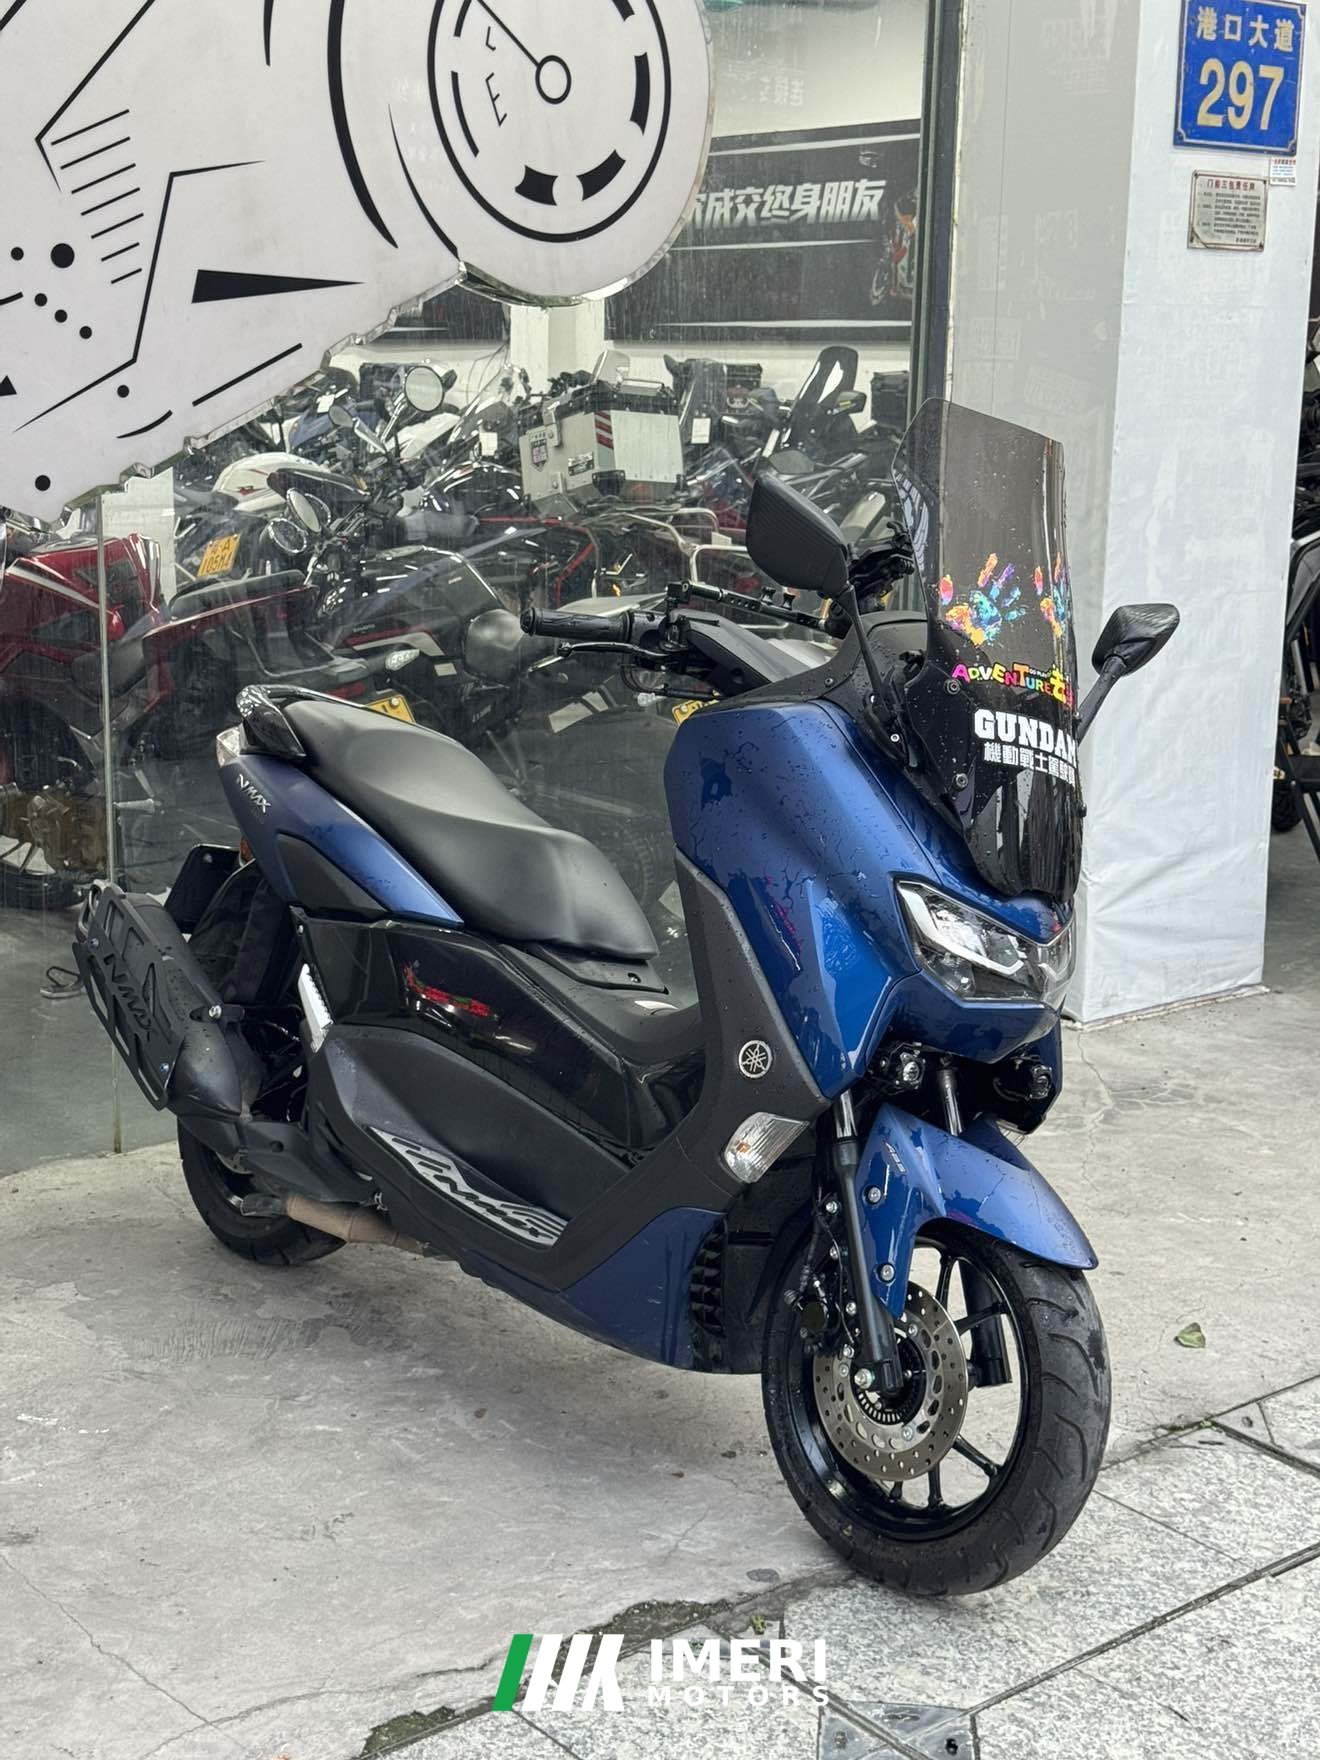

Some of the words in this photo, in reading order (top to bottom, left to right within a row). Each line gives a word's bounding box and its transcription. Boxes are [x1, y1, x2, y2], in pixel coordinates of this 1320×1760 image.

[1196, 6, 1295, 52] 港口大道
[1197, 58, 1285, 131] 297
[974, 708, 1077, 769] GUNDAM
